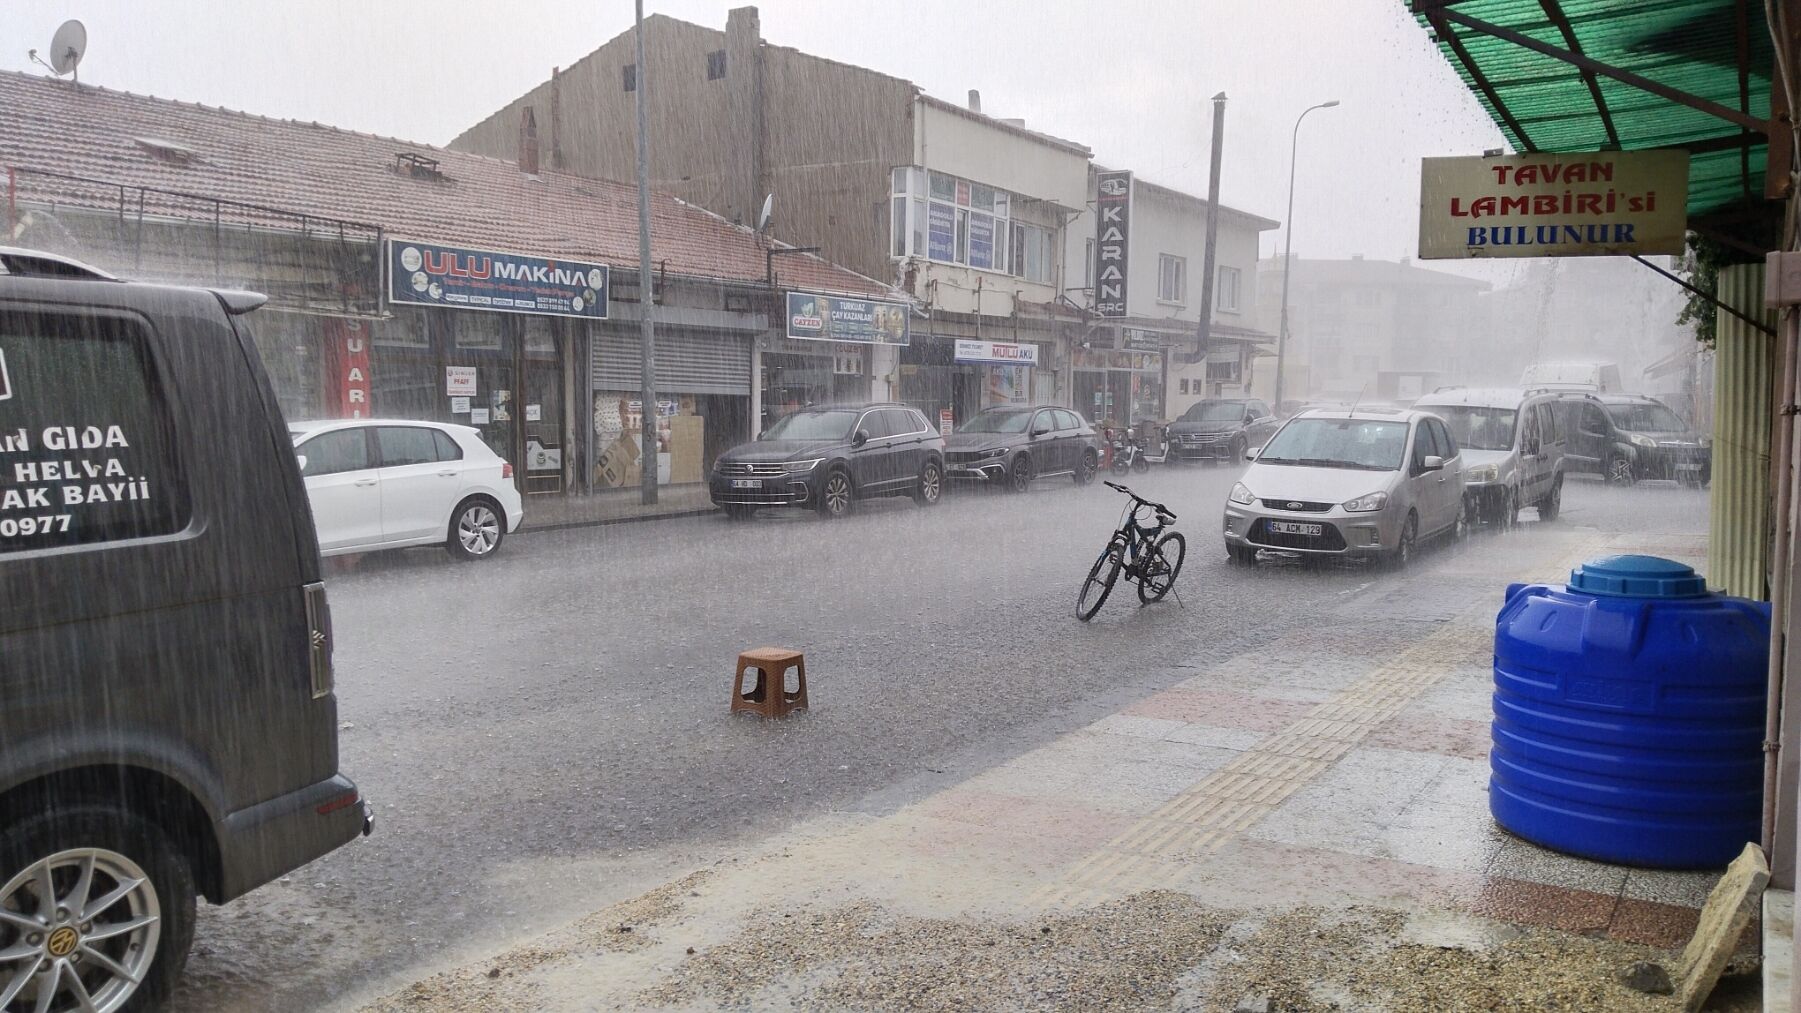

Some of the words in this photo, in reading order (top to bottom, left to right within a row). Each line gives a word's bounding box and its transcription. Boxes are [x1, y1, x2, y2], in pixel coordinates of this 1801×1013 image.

[1491, 162, 1613, 186] TAVAN
[1466, 223, 1637, 247] BULUNUR
[1100, 206, 1124, 299] KARAN
[423, 250, 491, 280] ULU
[494, 261, 588, 287] MAKİNA
[1097, 302, 1124, 312] SRC
[42, 425, 129, 451] GIDA
[15, 458, 126, 482] HELVA
[0, 514, 72, 537] 0977
[1272, 522, 1281, 531] 64
[1306, 525, 1321, 535] 129
